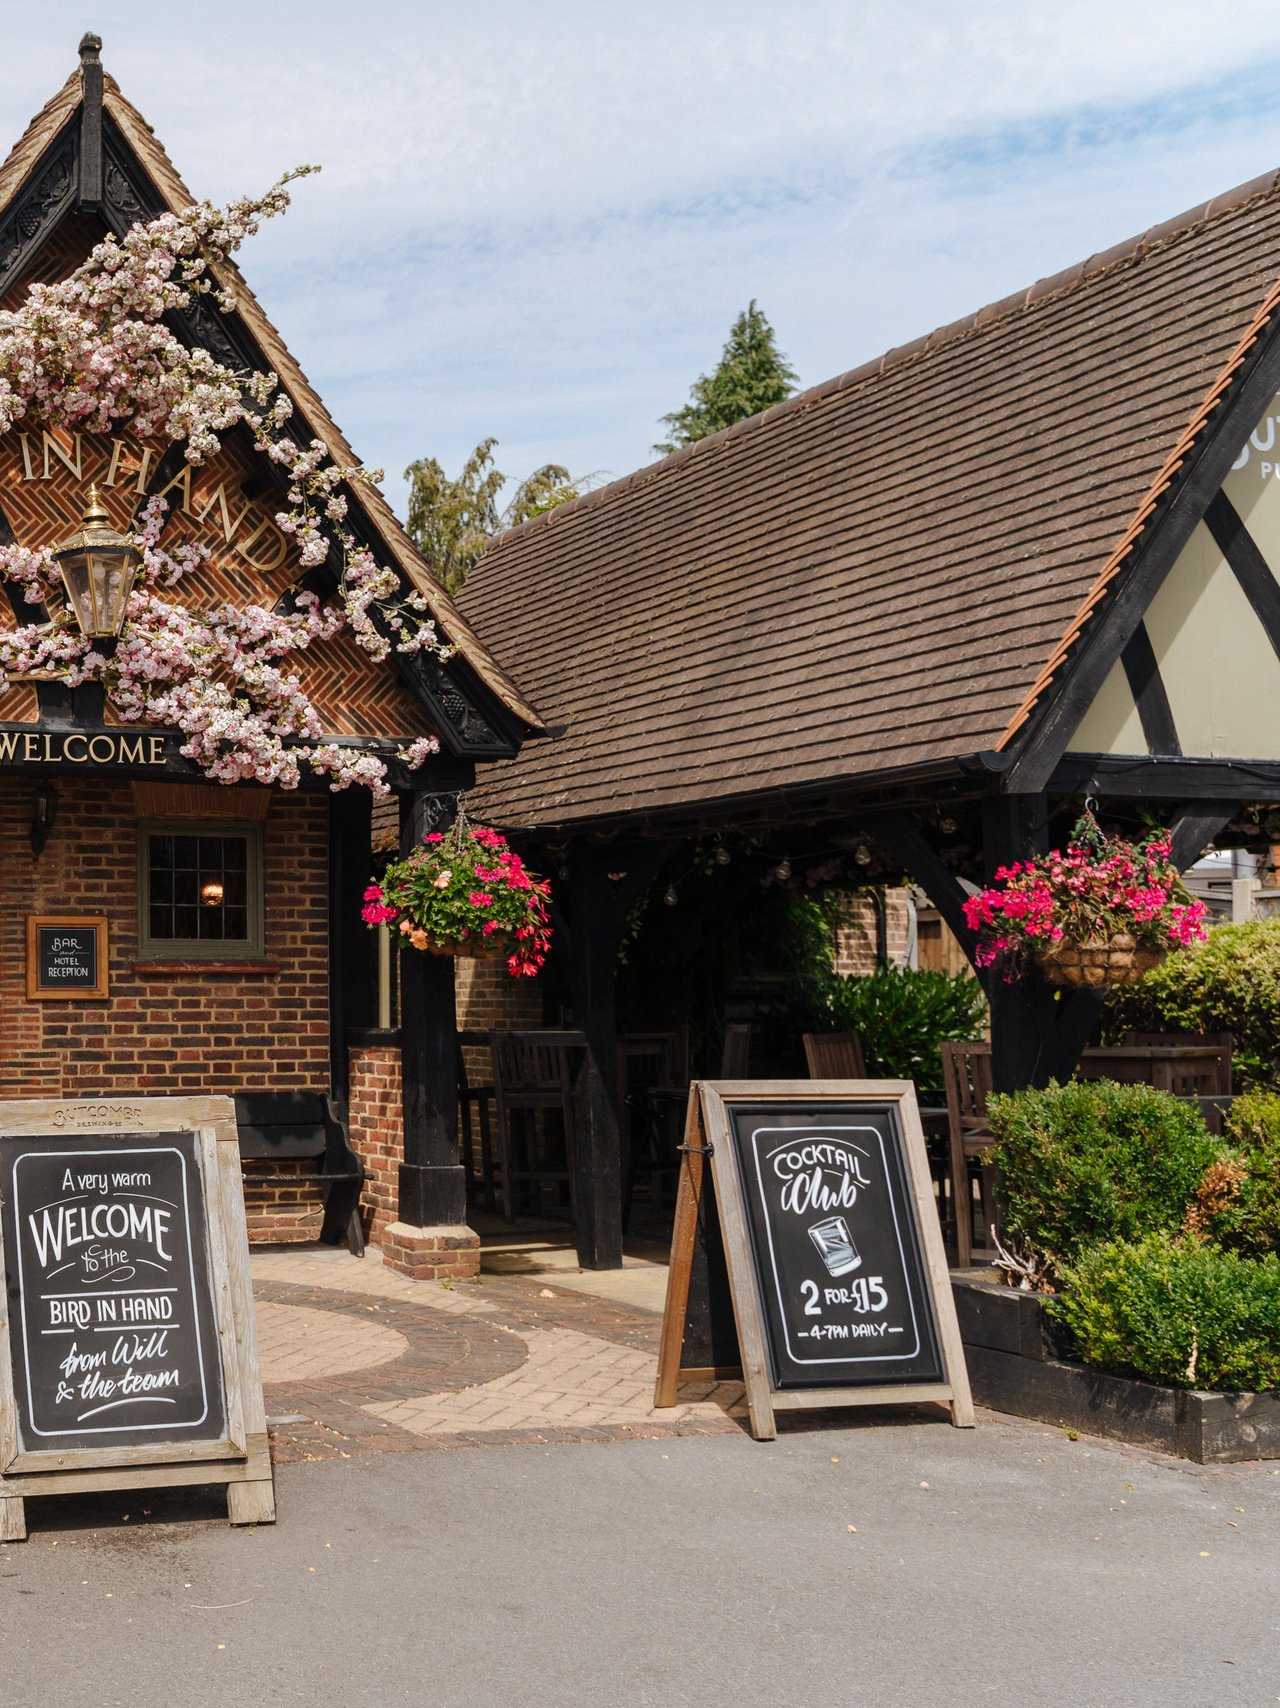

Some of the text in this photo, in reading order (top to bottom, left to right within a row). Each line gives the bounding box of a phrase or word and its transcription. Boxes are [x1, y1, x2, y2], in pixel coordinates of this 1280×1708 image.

[18, 430, 83, 482] IN
[102, 438, 287, 572] HAND
[51, 938, 82, 951] BAR
[54, 957, 80, 965] HOTEL
[48, 967, 88, 977] RECEPTION
[62, 1168, 152, 1195] A very warm
[773, 1144, 871, 1184] COCKTAIL
[780, 1166, 857, 1214] Club
[28, 1203, 173, 1268] WELCOME
[81, 1248, 129, 1272] to the
[50, 1296, 173, 1330] BIRD IN HAND
[800, 1276, 888, 1315] 2 FOR £15
[851, 1321, 888, 1338] DAILY
[59, 1329, 169, 1379] from Will
[55, 1367, 179, 1404] & the team
